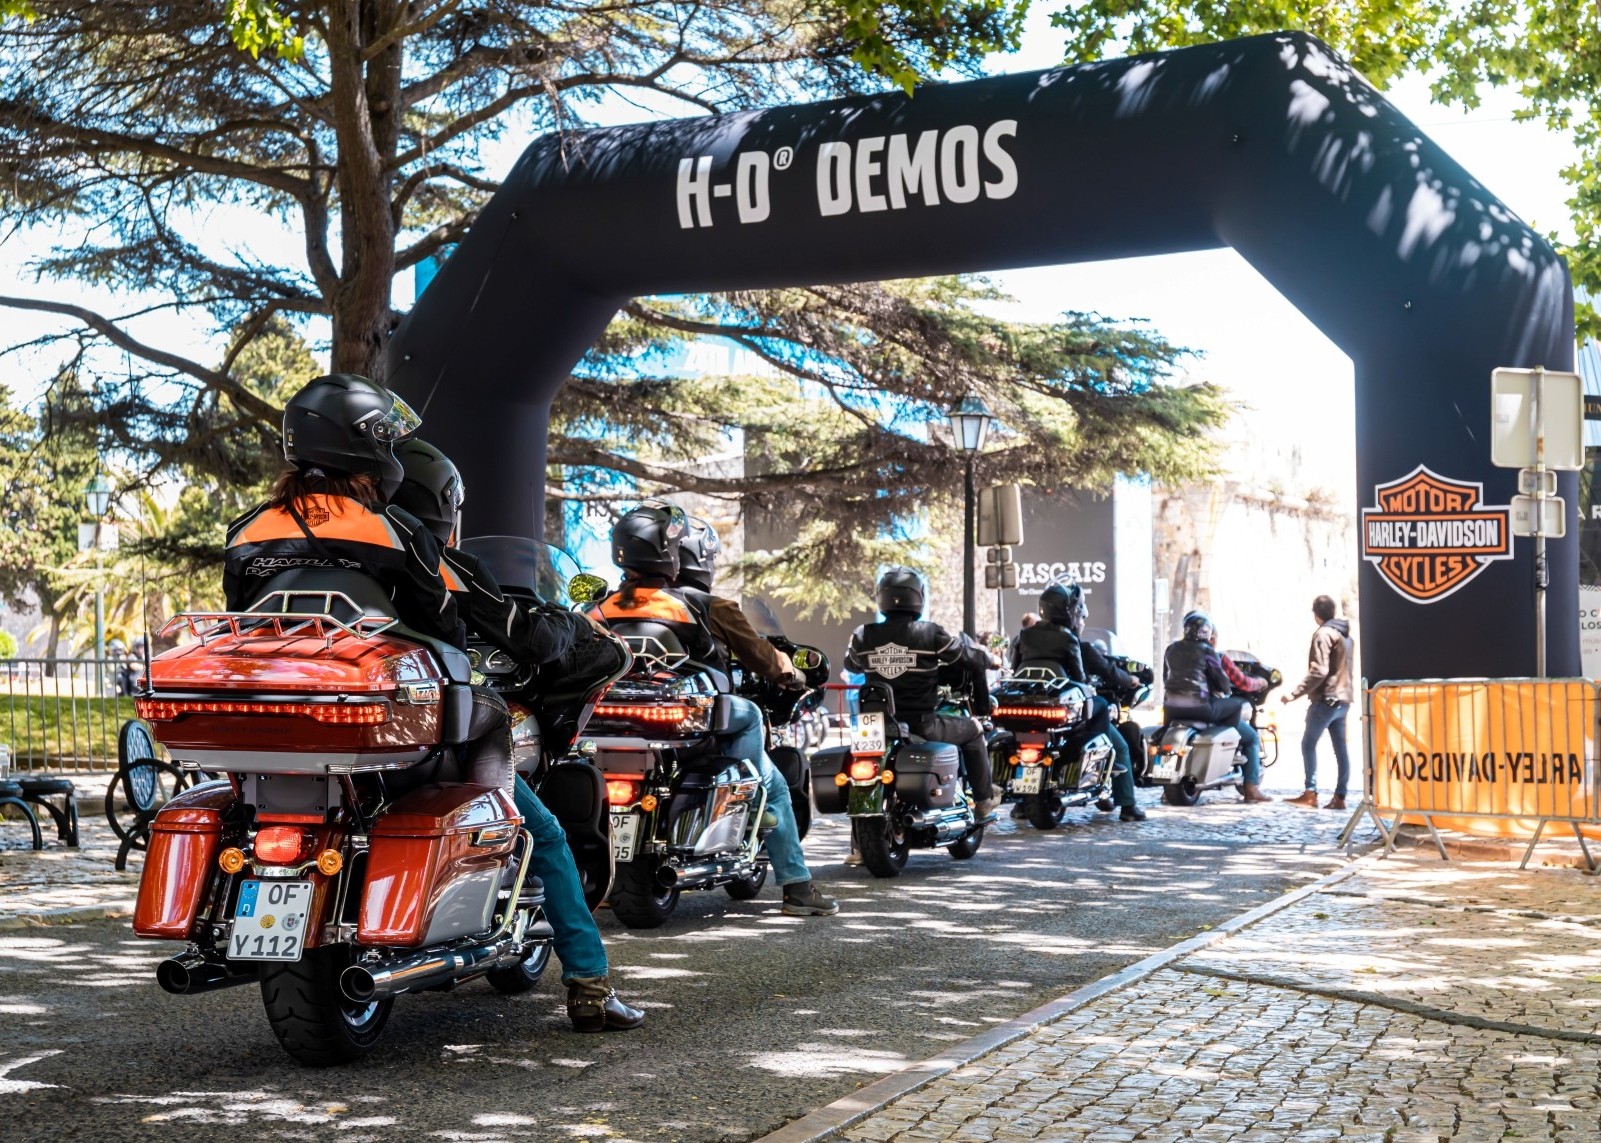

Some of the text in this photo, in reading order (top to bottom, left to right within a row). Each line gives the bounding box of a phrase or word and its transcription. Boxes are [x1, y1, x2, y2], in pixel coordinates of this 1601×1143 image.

[816, 119, 1019, 217] DEMOS
[1389, 482, 1462, 512] MOTOR
[1368, 519, 1499, 548] HARLEY-DAVIDSON
[1390, 556, 1463, 591] CYCLES
[880, 647, 904, 655] MOTOR
[862, 715, 877, 726] OF
[268, 884, 300, 905] OF
